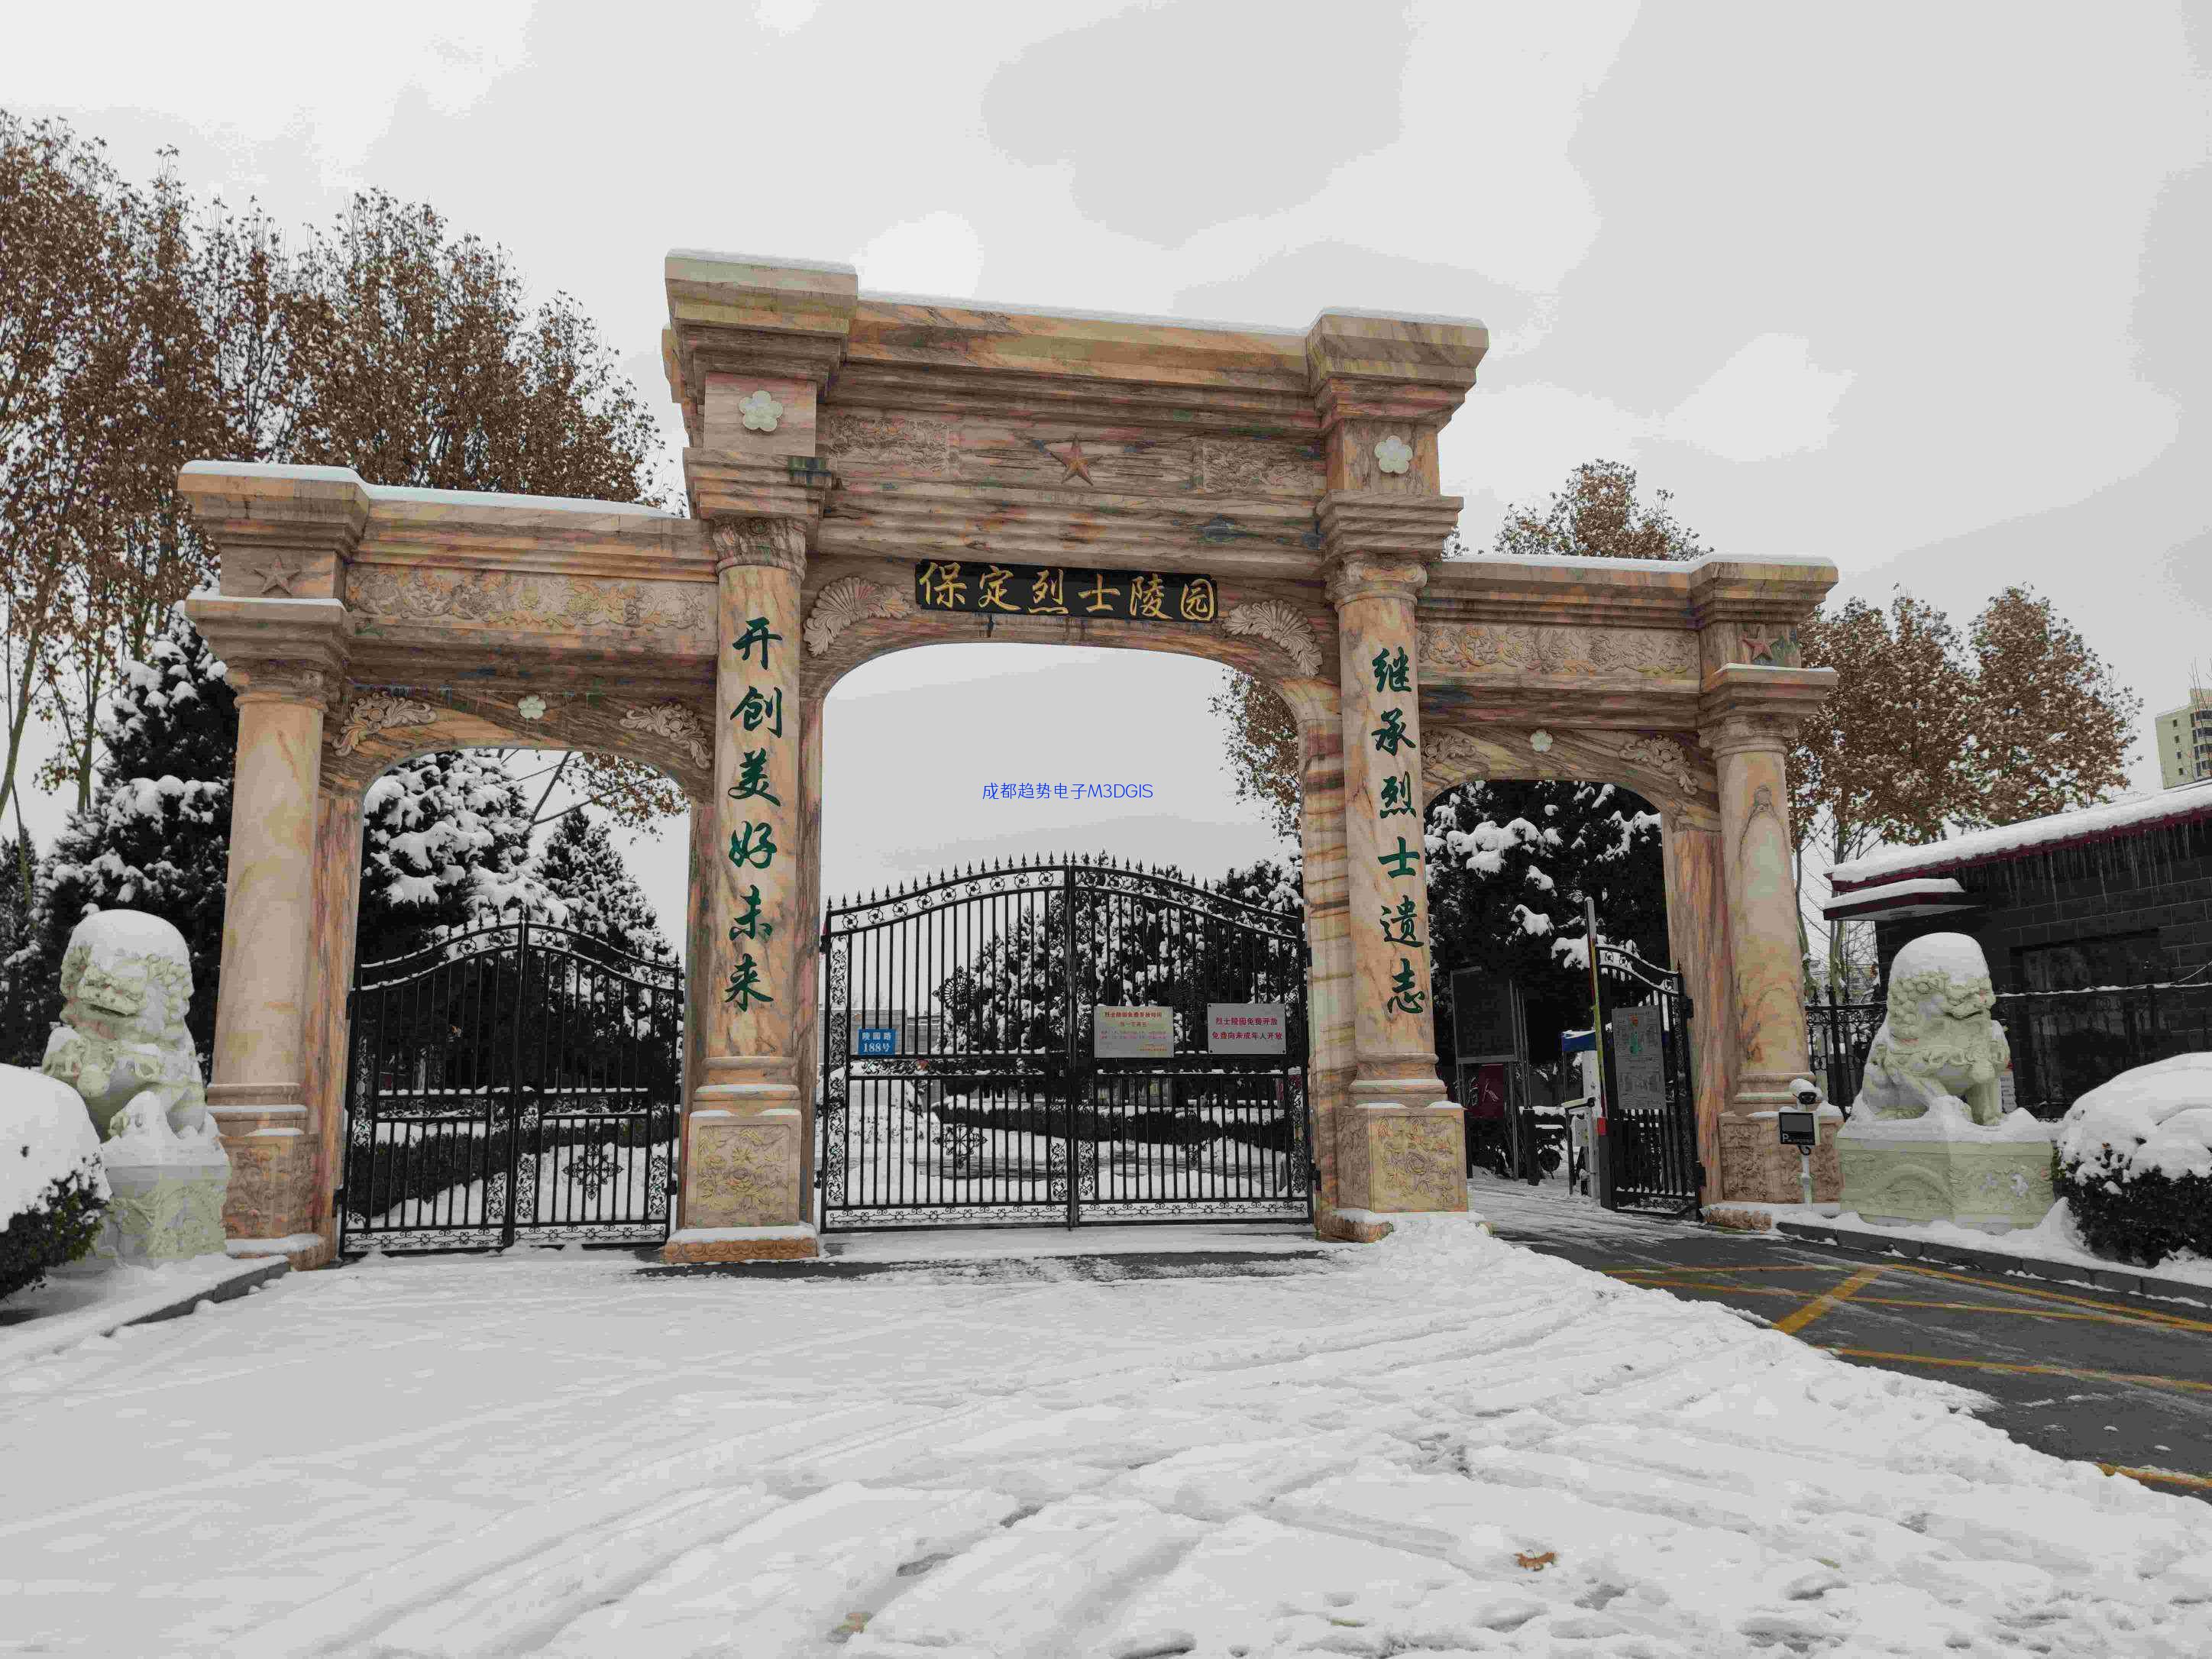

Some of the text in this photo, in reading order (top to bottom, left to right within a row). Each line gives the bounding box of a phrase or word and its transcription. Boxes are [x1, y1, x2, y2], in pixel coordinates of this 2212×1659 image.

[919, 561, 1214, 622] 保定烈士陵园
[725, 616, 783, 1013] 开创美好未来
[1372, 646, 1425, 1015] 继承烈士遗志
[862, 1032, 891, 1040] 陵园路
[863, 1043, 891, 1053] 188号
[1212, 1031, 1282, 1040] 免费向未成年人开放
